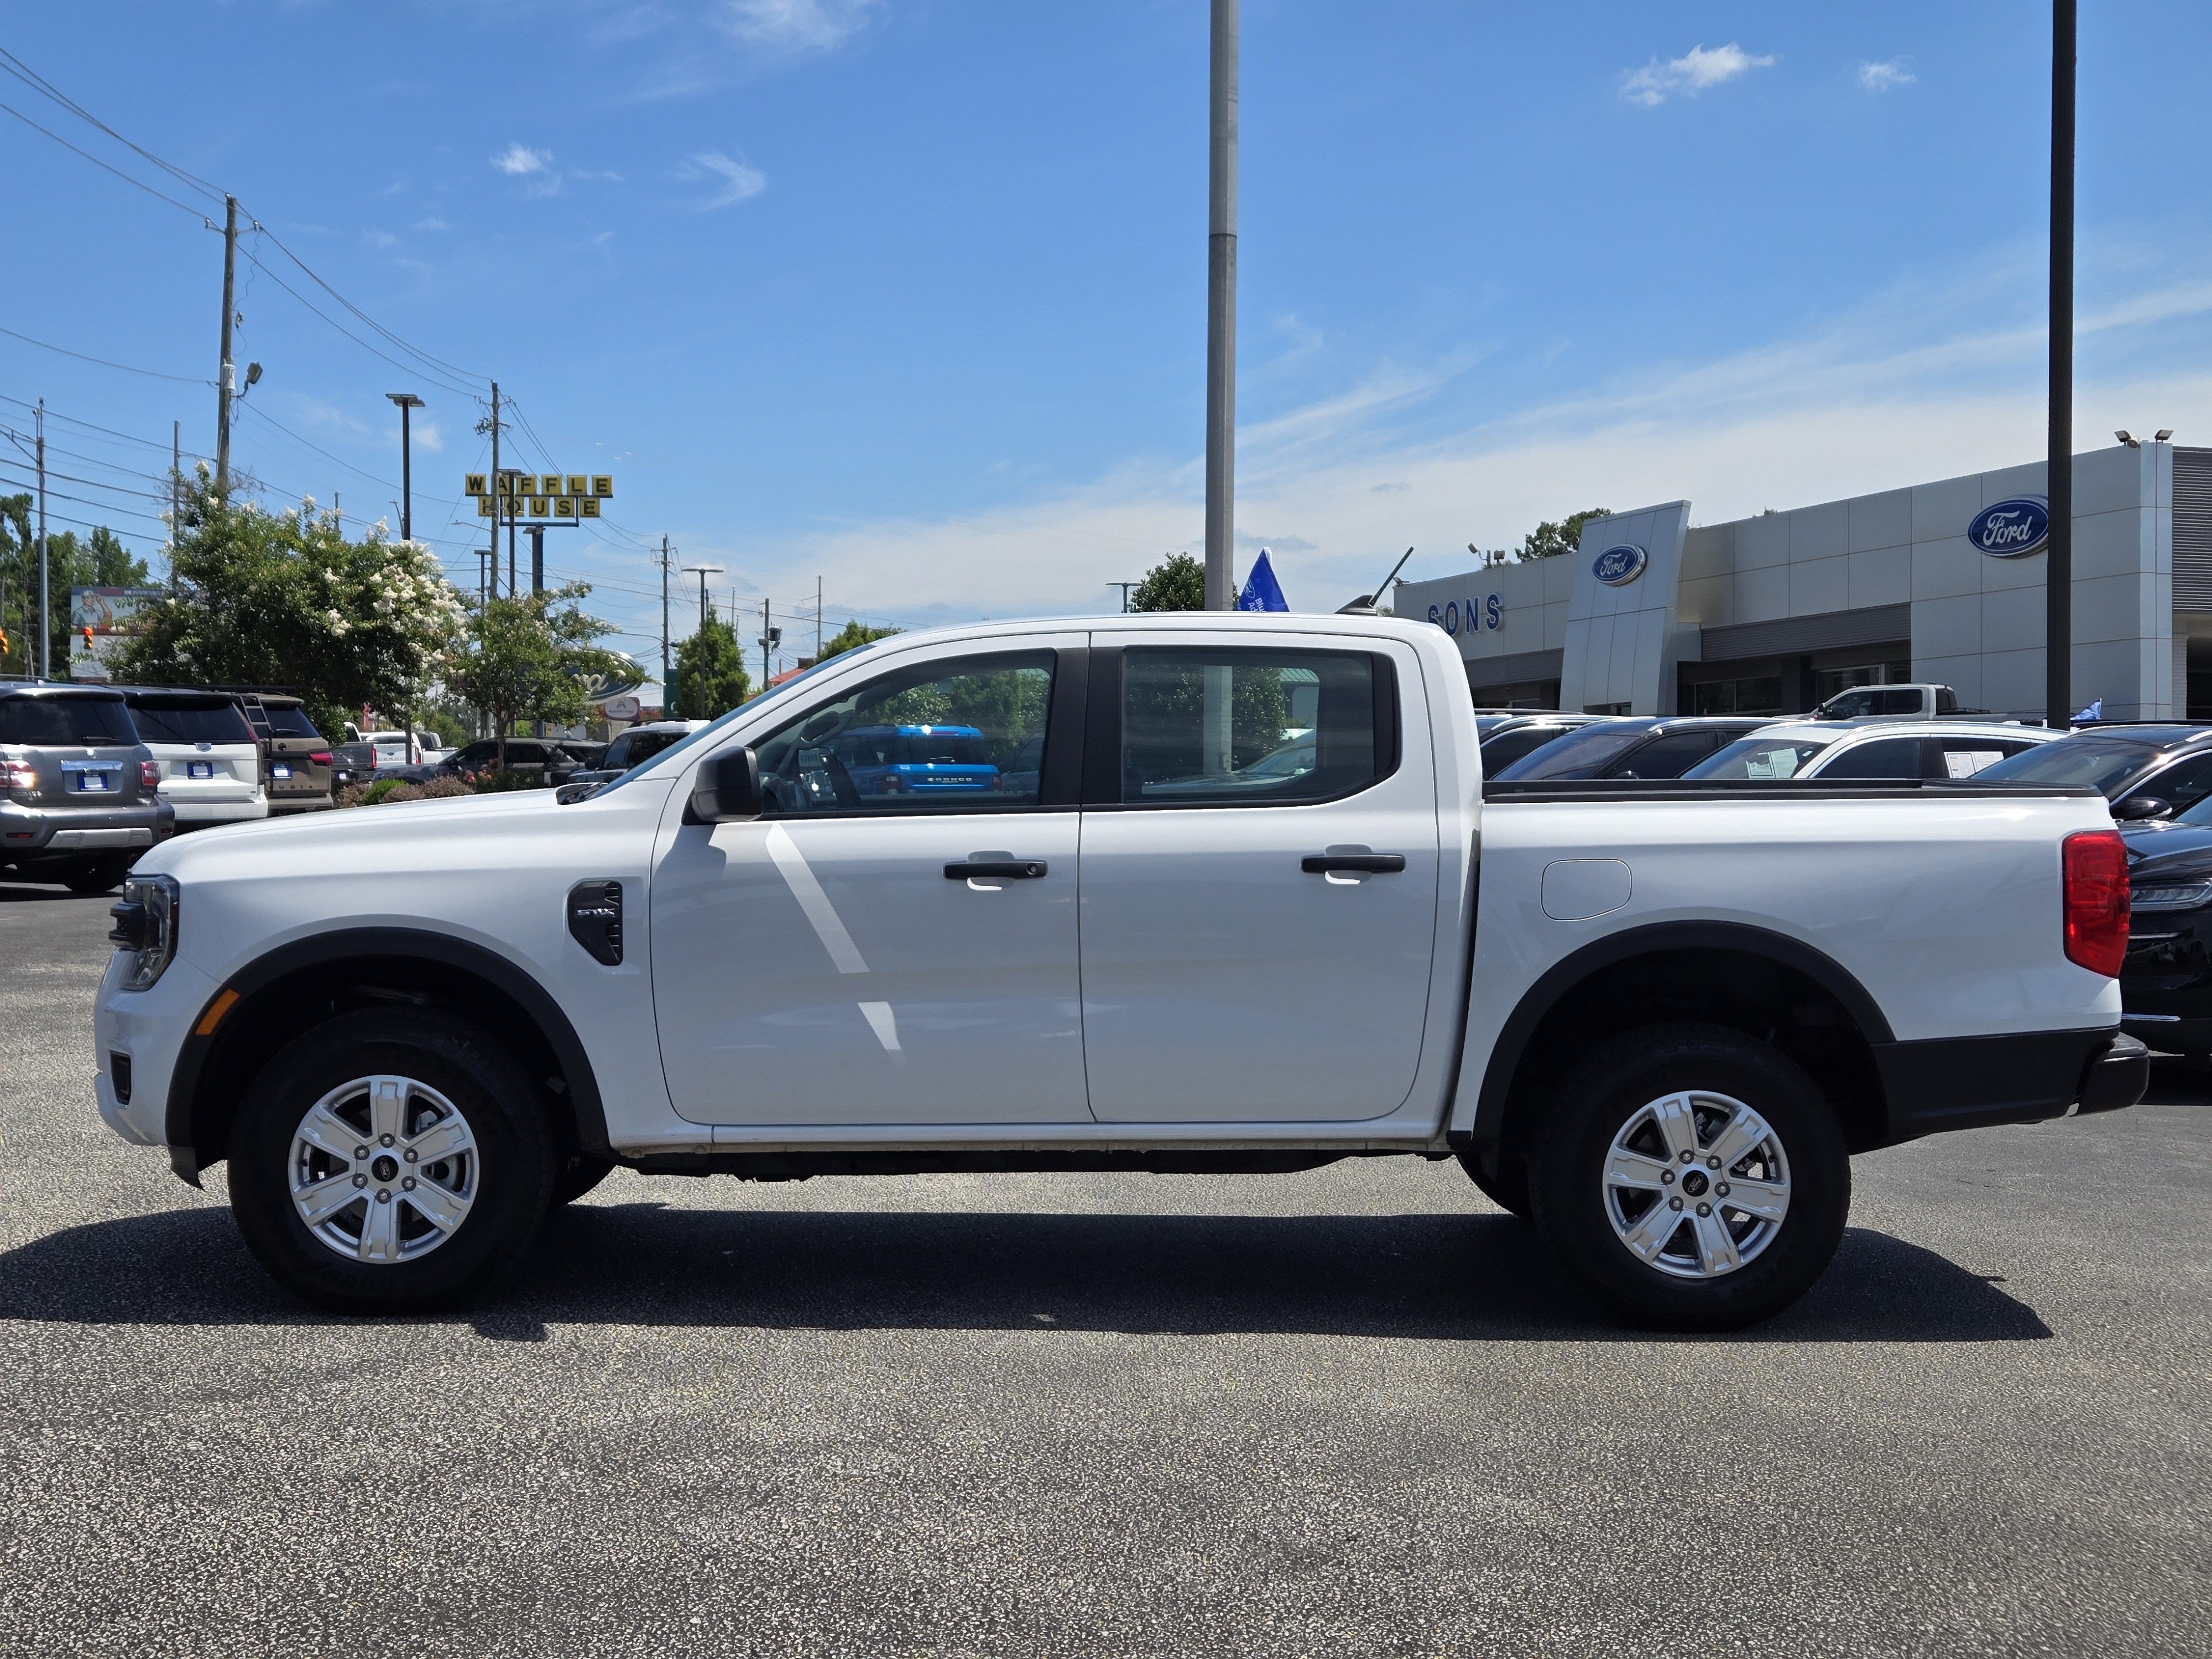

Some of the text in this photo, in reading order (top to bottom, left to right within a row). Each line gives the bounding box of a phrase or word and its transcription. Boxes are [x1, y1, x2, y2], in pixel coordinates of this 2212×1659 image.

[468, 476, 608, 493] WAFFLE
[482, 499, 596, 515] HOUSE
[1983, 510, 2033, 546] Ford
[1599, 553, 1627, 576] Ford
[1427, 592, 1501, 637] SONS
